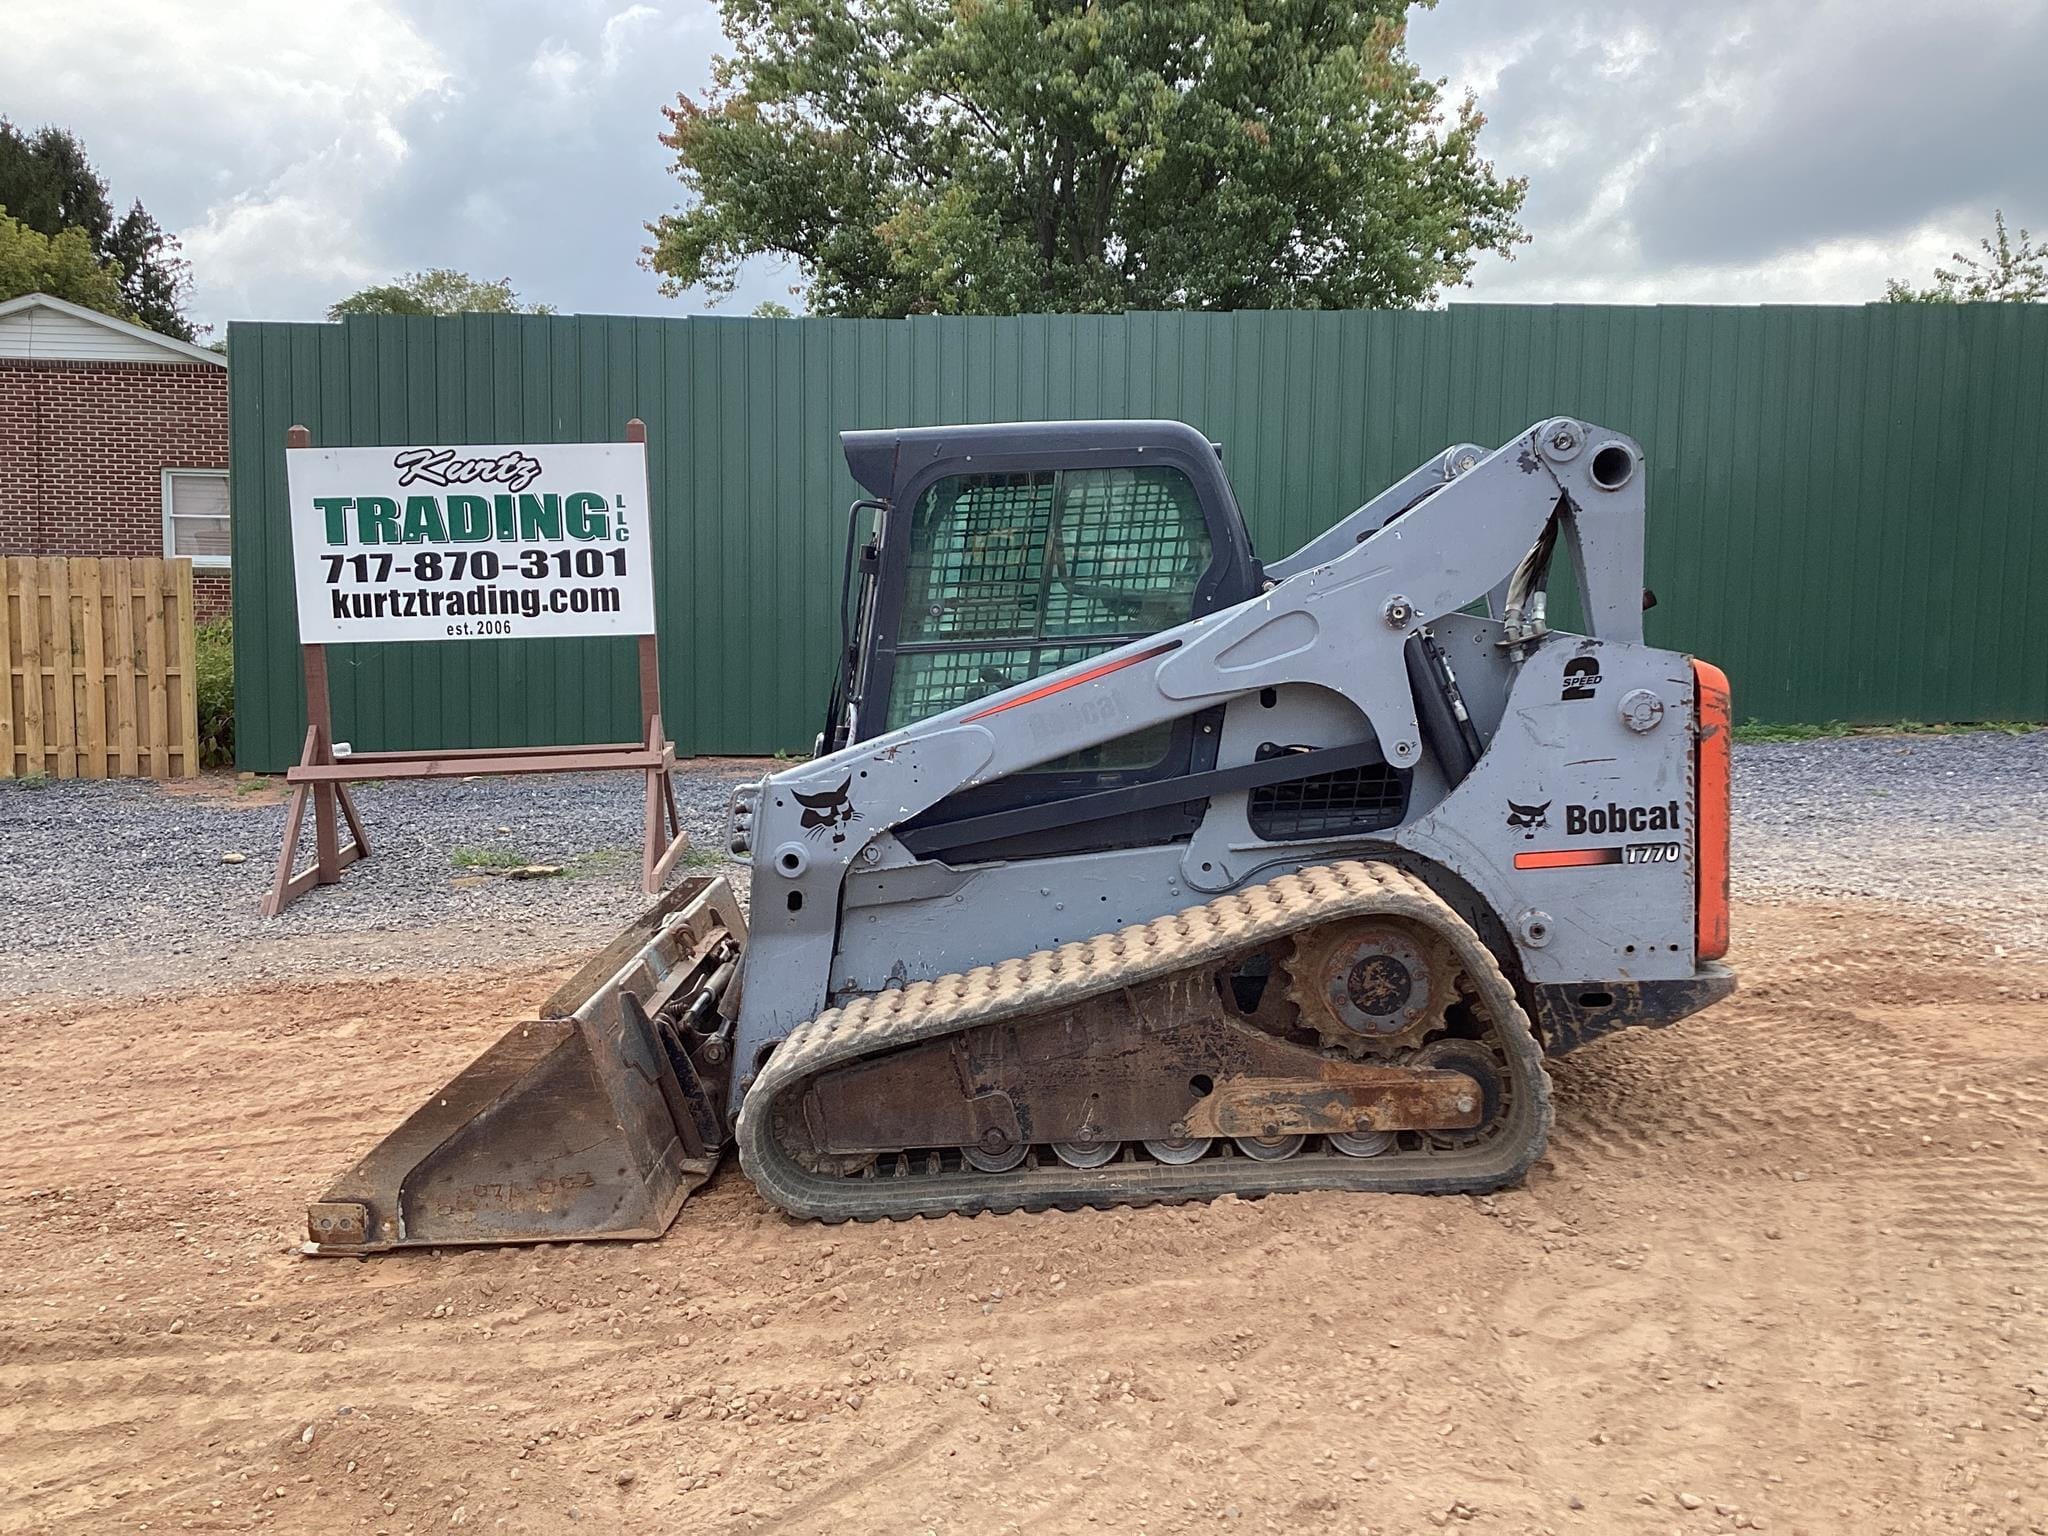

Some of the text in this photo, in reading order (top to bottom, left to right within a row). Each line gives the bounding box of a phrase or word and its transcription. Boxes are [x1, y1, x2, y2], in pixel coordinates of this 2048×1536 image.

[394, 448, 542, 493] Kurtz
[313, 491, 630, 546] TRADING LLC
[320, 547, 627, 584] 717-870-3101
[331, 584, 621, 619] kurtztrading.com
[446, 620, 511, 636] est. 2006
[1561, 656, 1603, 701] 2 SPEED
[1566, 800, 1680, 836] Bobcat
[1625, 842, 1681, 865] T770
